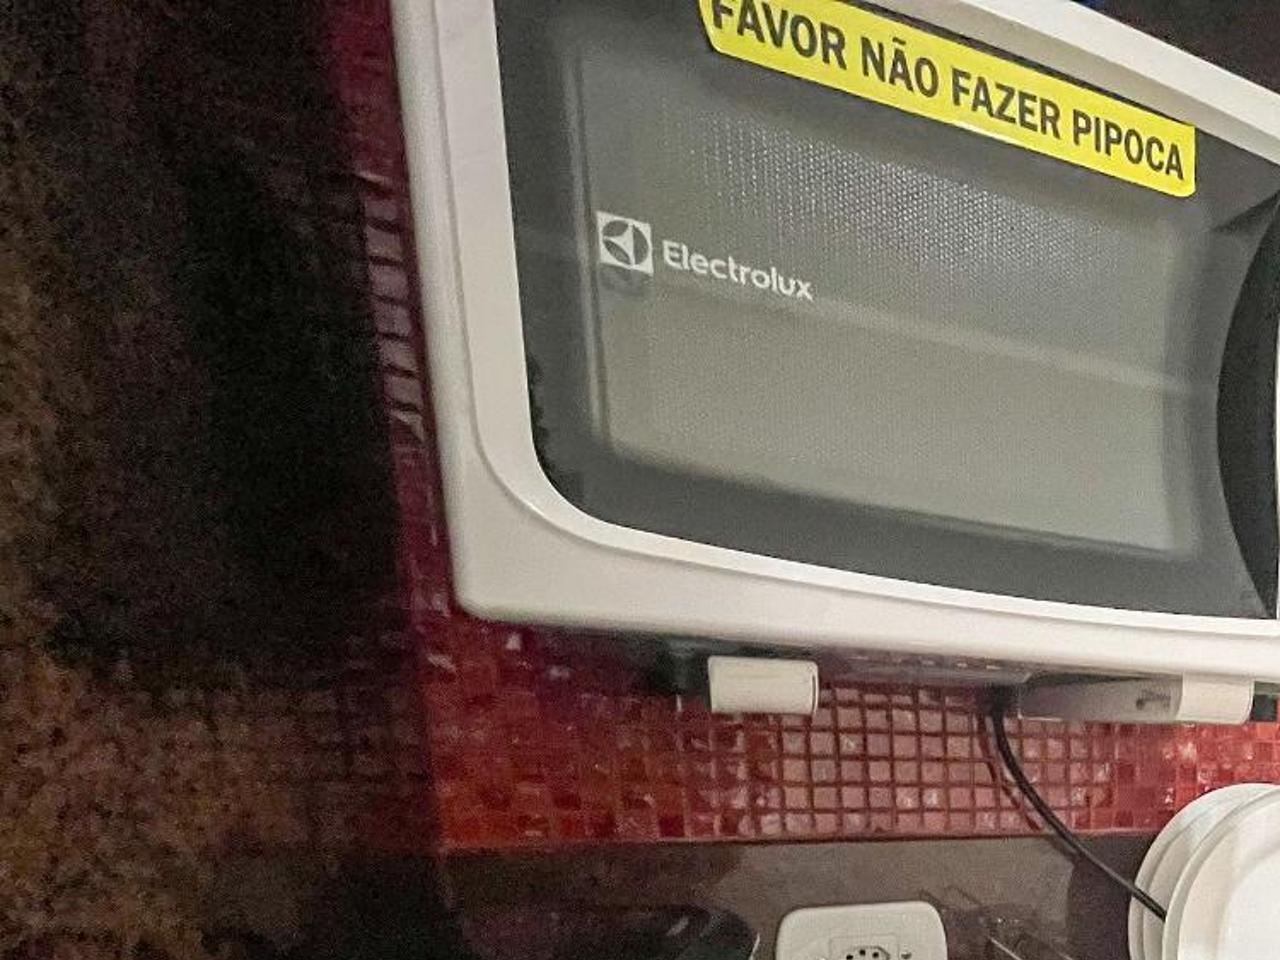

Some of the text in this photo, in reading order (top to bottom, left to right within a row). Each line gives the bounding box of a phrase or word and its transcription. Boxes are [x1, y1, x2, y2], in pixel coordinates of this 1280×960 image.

[711, 0, 1185, 180] FAVOR NÃO FAZER PIPOCA
[662, 239, 813, 301] Electrolux
